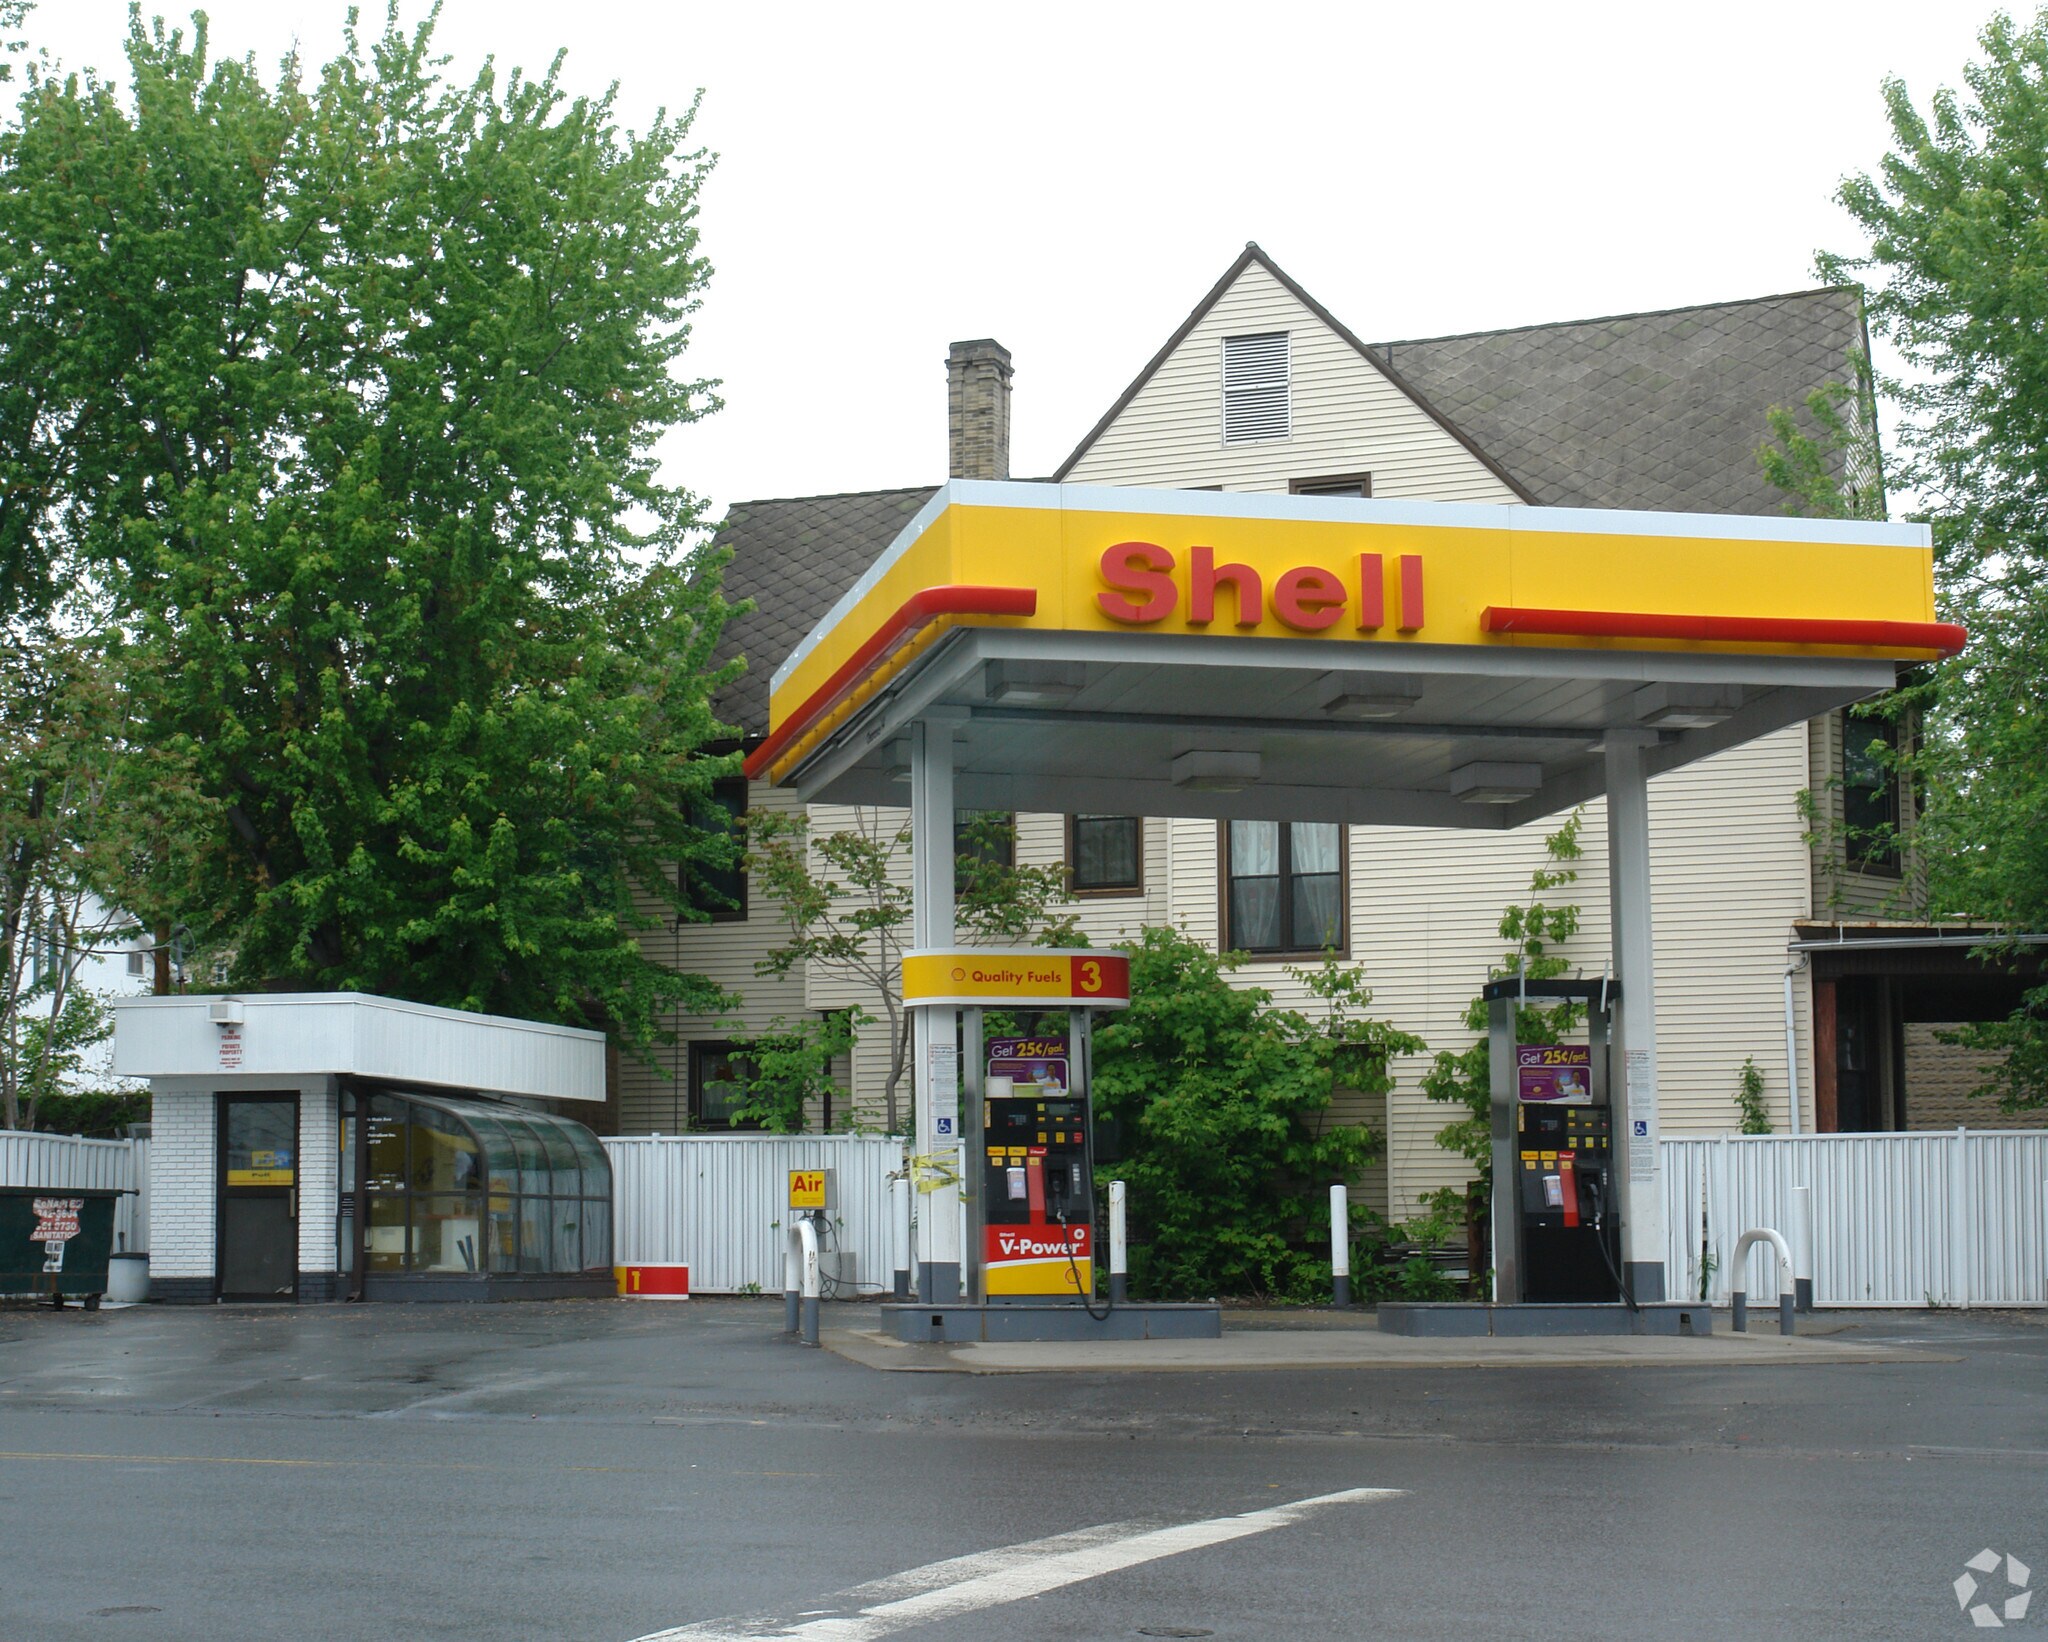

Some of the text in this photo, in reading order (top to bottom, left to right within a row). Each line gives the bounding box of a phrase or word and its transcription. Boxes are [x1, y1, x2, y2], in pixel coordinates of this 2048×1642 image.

[1096, 541, 1425, 633] Shell
[972, 970, 1061, 985] Quality Fuels
[1080, 961, 1102, 992] 3
[991, 1045, 1013, 1058] Get
[1520, 1053, 1540, 1065] Get
[793, 1174, 822, 1192] Air
[1000, 1239, 1079, 1255] V-Power
[632, 1271, 640, 1291] 1
